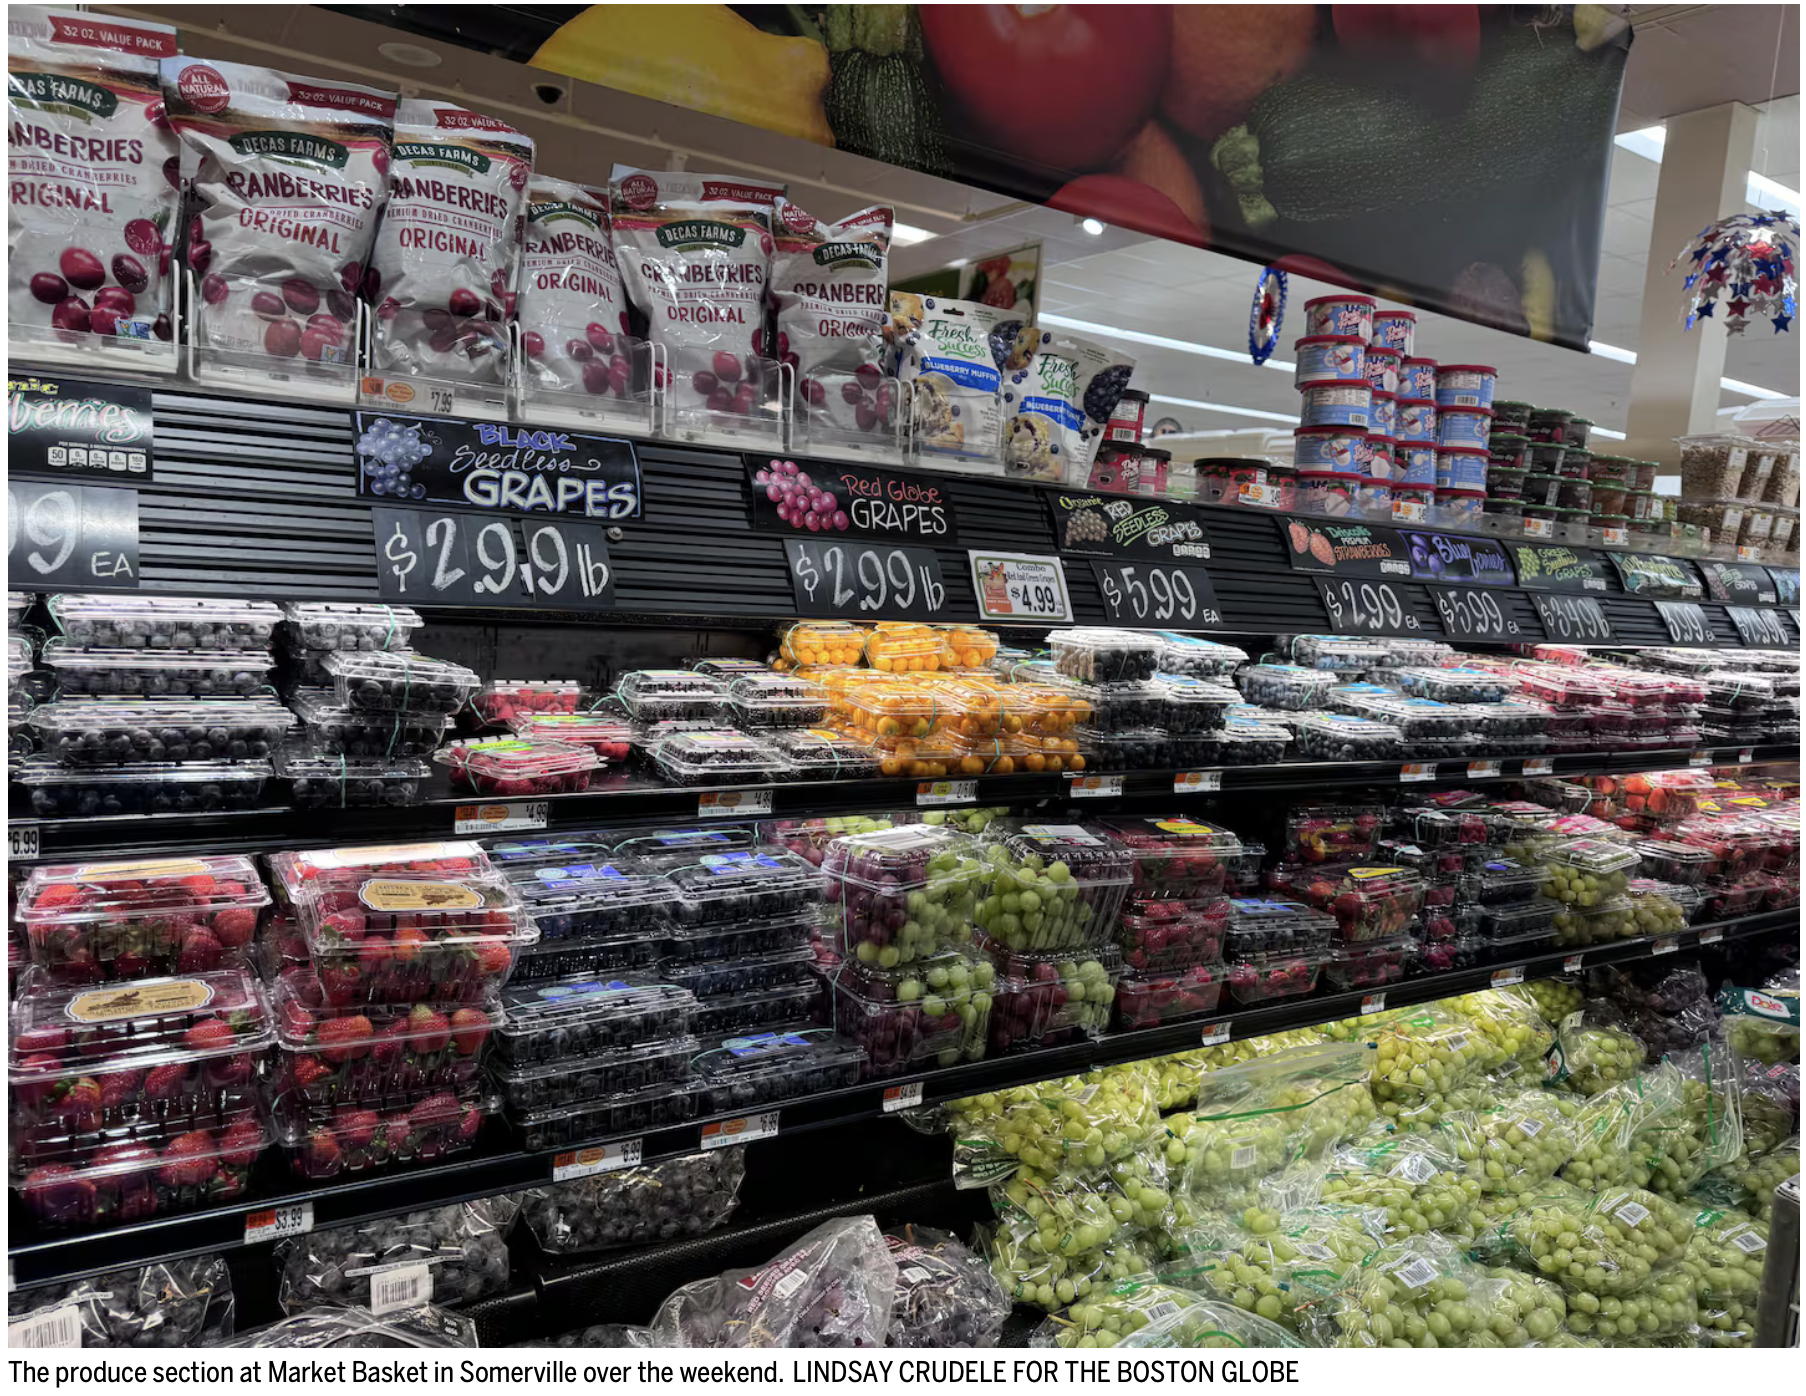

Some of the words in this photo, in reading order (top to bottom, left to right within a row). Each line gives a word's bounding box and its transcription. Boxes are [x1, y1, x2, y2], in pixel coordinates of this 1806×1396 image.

[64, 25, 78, 37] 32
[81, 29, 98, 41] OZ.
[100, 31, 132, 46] VALUE
[136, 36, 163, 51] PACK
[180, 83, 228, 94] NATURAL
[191, 74, 209, 85] ALL
[8, 76, 46, 96] ECAS
[52, 80, 103, 110] FARMS
[298, 90, 311, 100] 32
[328, 95, 358, 105] VALUE
[359, 98, 383, 111] PACK
[444, 115, 456, 126] 32
[471, 118, 497, 127] VALUE
[242, 136, 285, 153] DECAS
[290, 139, 336, 162] FARMS
[397, 145, 436, 157] DECAS
[439, 148, 479, 167] FARMS
[22, 160, 55, 172] DRIED
[62, 165, 138, 186] CRANBERRIES
[8, 181, 114, 214] RIGINAL
[709, 186, 718, 196] 32
[731, 189, 753, 200] VALUE
[754, 192, 774, 201] PACK
[303, 210, 364, 231] CRANBERRIES
[386, 207, 418, 218] REMIUM
[421, 210, 449, 223] DRIED
[239, 207, 341, 254] ORIGINAL
[665, 226, 698, 242] DECAS
[701, 226, 736, 243] FARMS
[399, 227, 487, 261] ORIGINAL
[525, 232, 617, 269] RANBERRIE
[822, 243, 852, 260] DECAS
[537, 272, 614, 304] ORIGINAL
[667, 305, 747, 325] ORIGINAL
[928, 319, 978, 343] Fresh
[937, 336, 987, 358] Success
[923, 361, 970, 375] BLUEBERRY
[971, 368, 997, 382] MUFFIN
[1037, 353, 1082, 381] Fresh
[431, 391, 453, 413] $7.99
[473, 423, 577, 453] BLACK
[52, 448, 64, 459] 50
[450, 445, 601, 474] Seedless
[463, 469, 638, 520] GRAPES
[841, 474, 883, 499] Red
[887, 480, 944, 505] Globe
[1059, 495, 1104, 510] Organic
[1103, 500, 1134, 521] RED
[851, 498, 948, 536] GRAPES
[1112, 508, 1170, 544] SEEDLESS
[1147, 520, 1203, 547] GRAPES
[1334, 543, 1392, 561] STRAWBERRIES
[1537, 547, 1572, 559] GREEN
[91, 551, 134, 579] EA
[576, 543, 610, 598] lb
[1016, 562, 1047, 573] Combo
[1555, 564, 1593, 581] GRAPES
[795, 543, 917, 611] $2.99
[918, 565, 946, 613] lb
[1103, 567, 1198, 621] $5.99
[1202, 608, 1221, 624] EA
[1324, 582, 1402, 630] $2.99
[1405, 614, 1421, 630] EA
[1437, 590, 1504, 634] $5.99
[1507, 620, 1521, 634] EA
[1751, 995, 1784, 1012] Dole
[275, 1206, 303, 1231] $3.99
